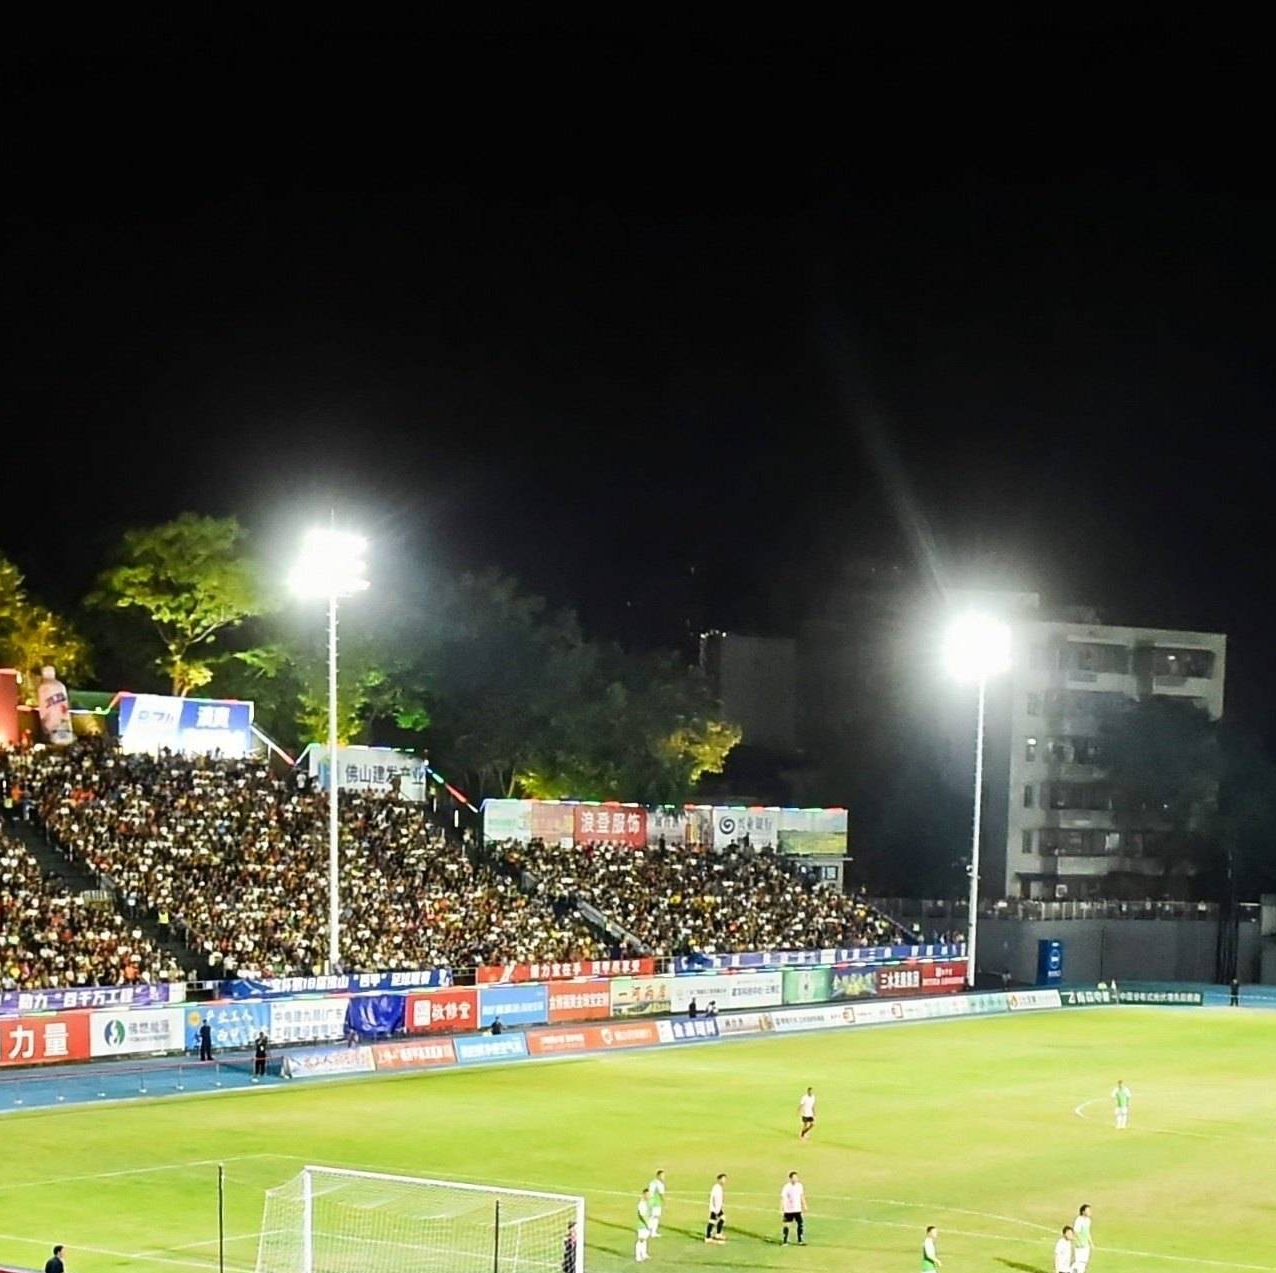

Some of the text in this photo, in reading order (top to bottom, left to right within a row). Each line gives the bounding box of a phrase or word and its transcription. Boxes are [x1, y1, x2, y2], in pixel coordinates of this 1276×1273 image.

[345, 764, 425, 785] 佛山建发产业
[581, 811, 641, 834] 浪登服饰
